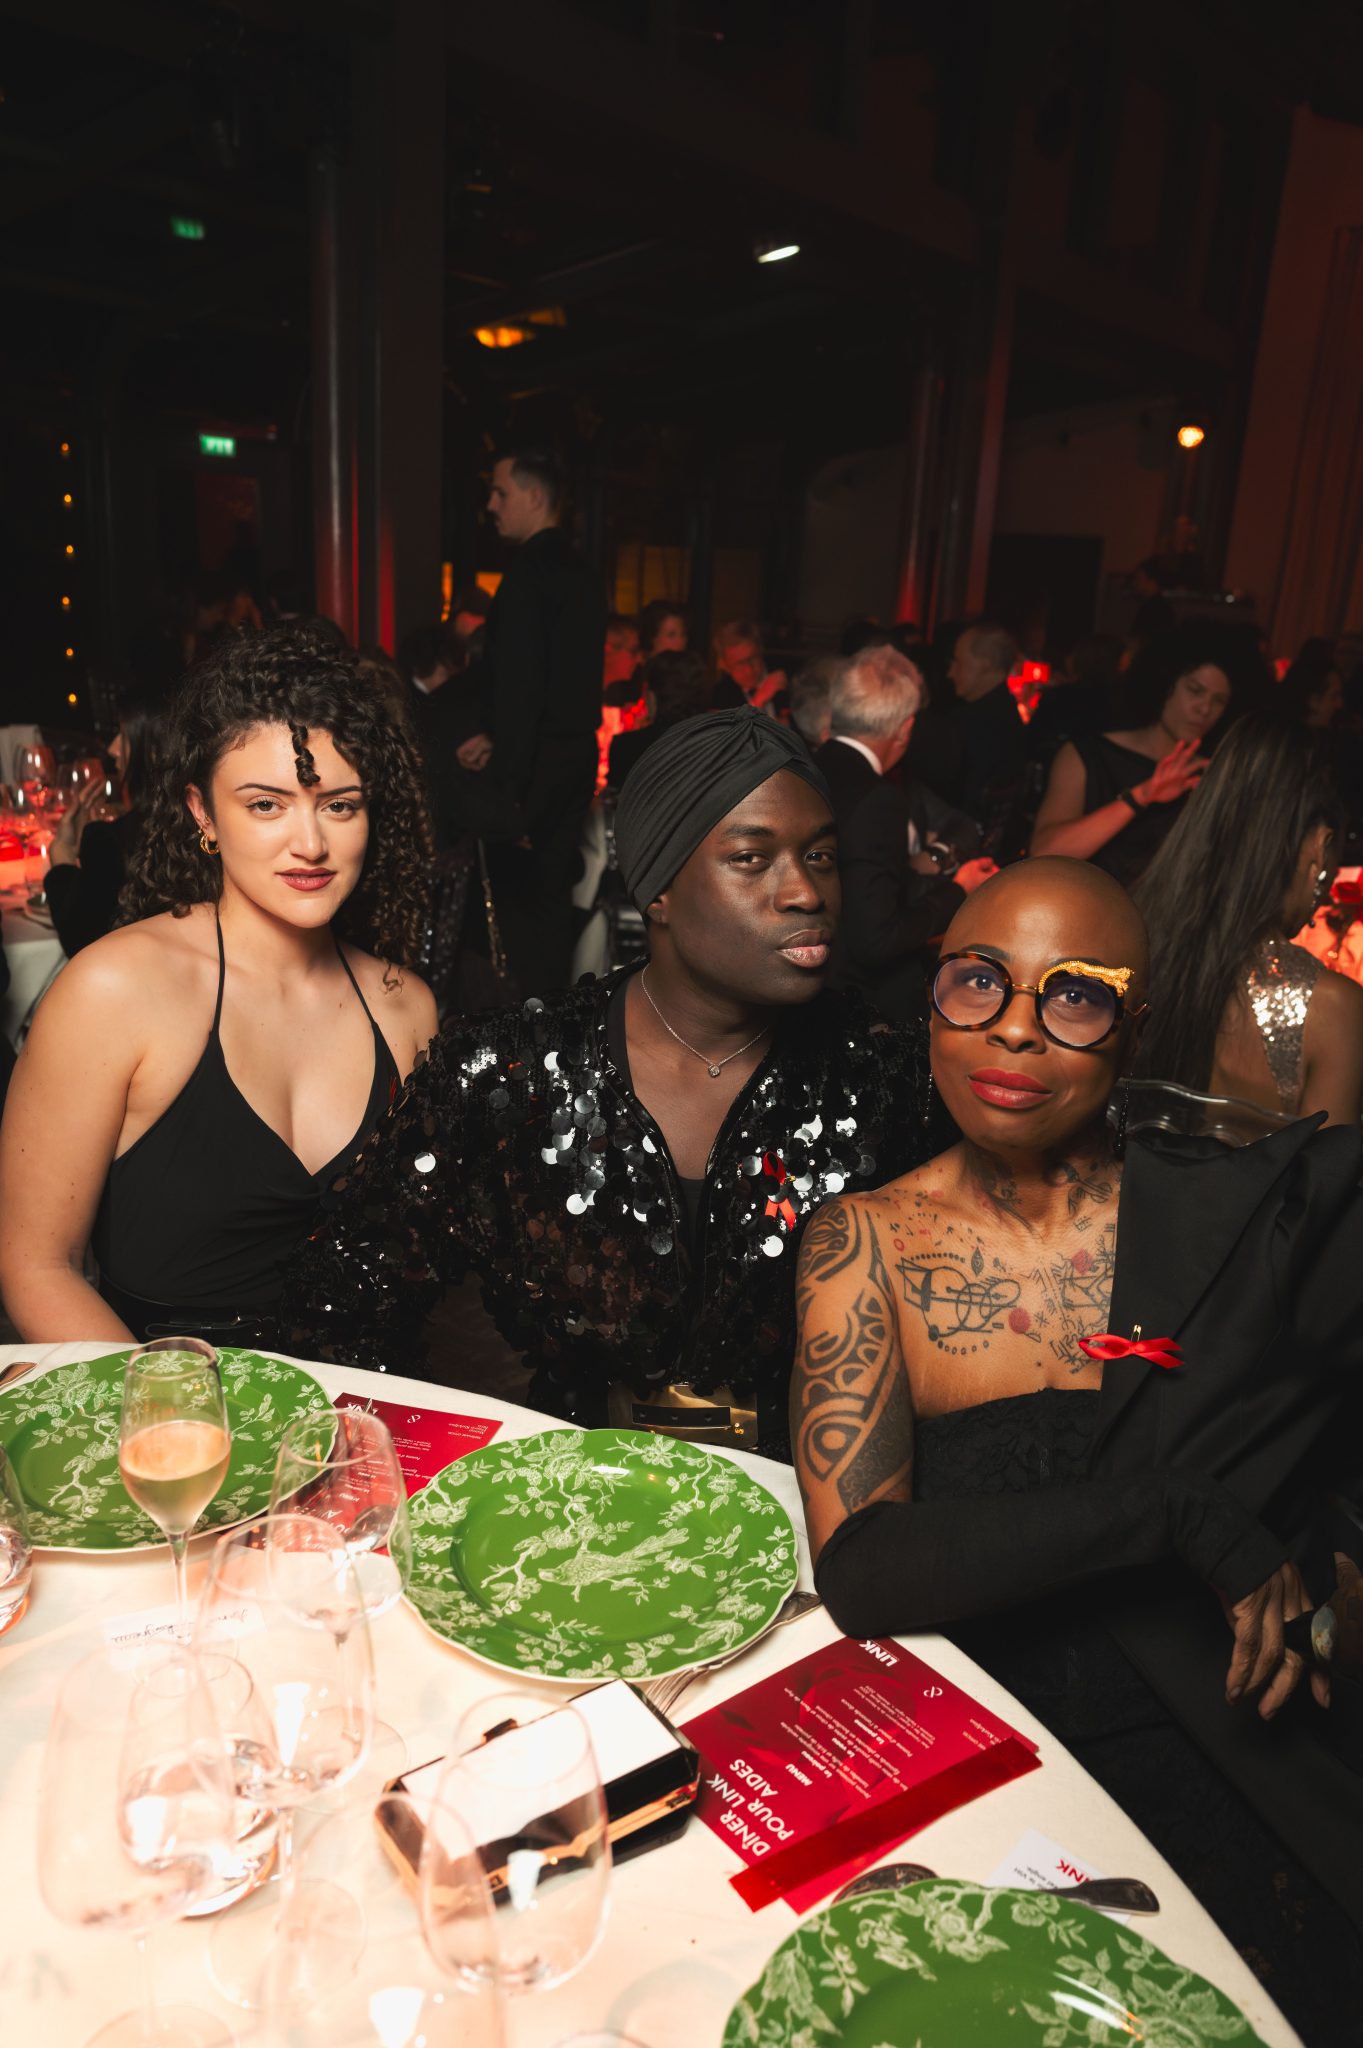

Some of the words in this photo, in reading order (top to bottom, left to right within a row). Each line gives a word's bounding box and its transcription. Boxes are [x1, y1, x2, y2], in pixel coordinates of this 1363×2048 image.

[860, 1640, 897, 1666] LINK
[854, 1719, 877, 1737] pomme
[832, 1738, 847, 1751] veau
[801, 1751, 826, 1770] poireau
[730, 1759, 777, 1796] AIDES
[786, 1764, 812, 1785] MENU
[824, 1770, 832, 1778] Le
[707, 1774, 745, 1807] LINK
[748, 1799, 793, 1840] POUR
[720, 1810, 770, 1855] DÎNER
